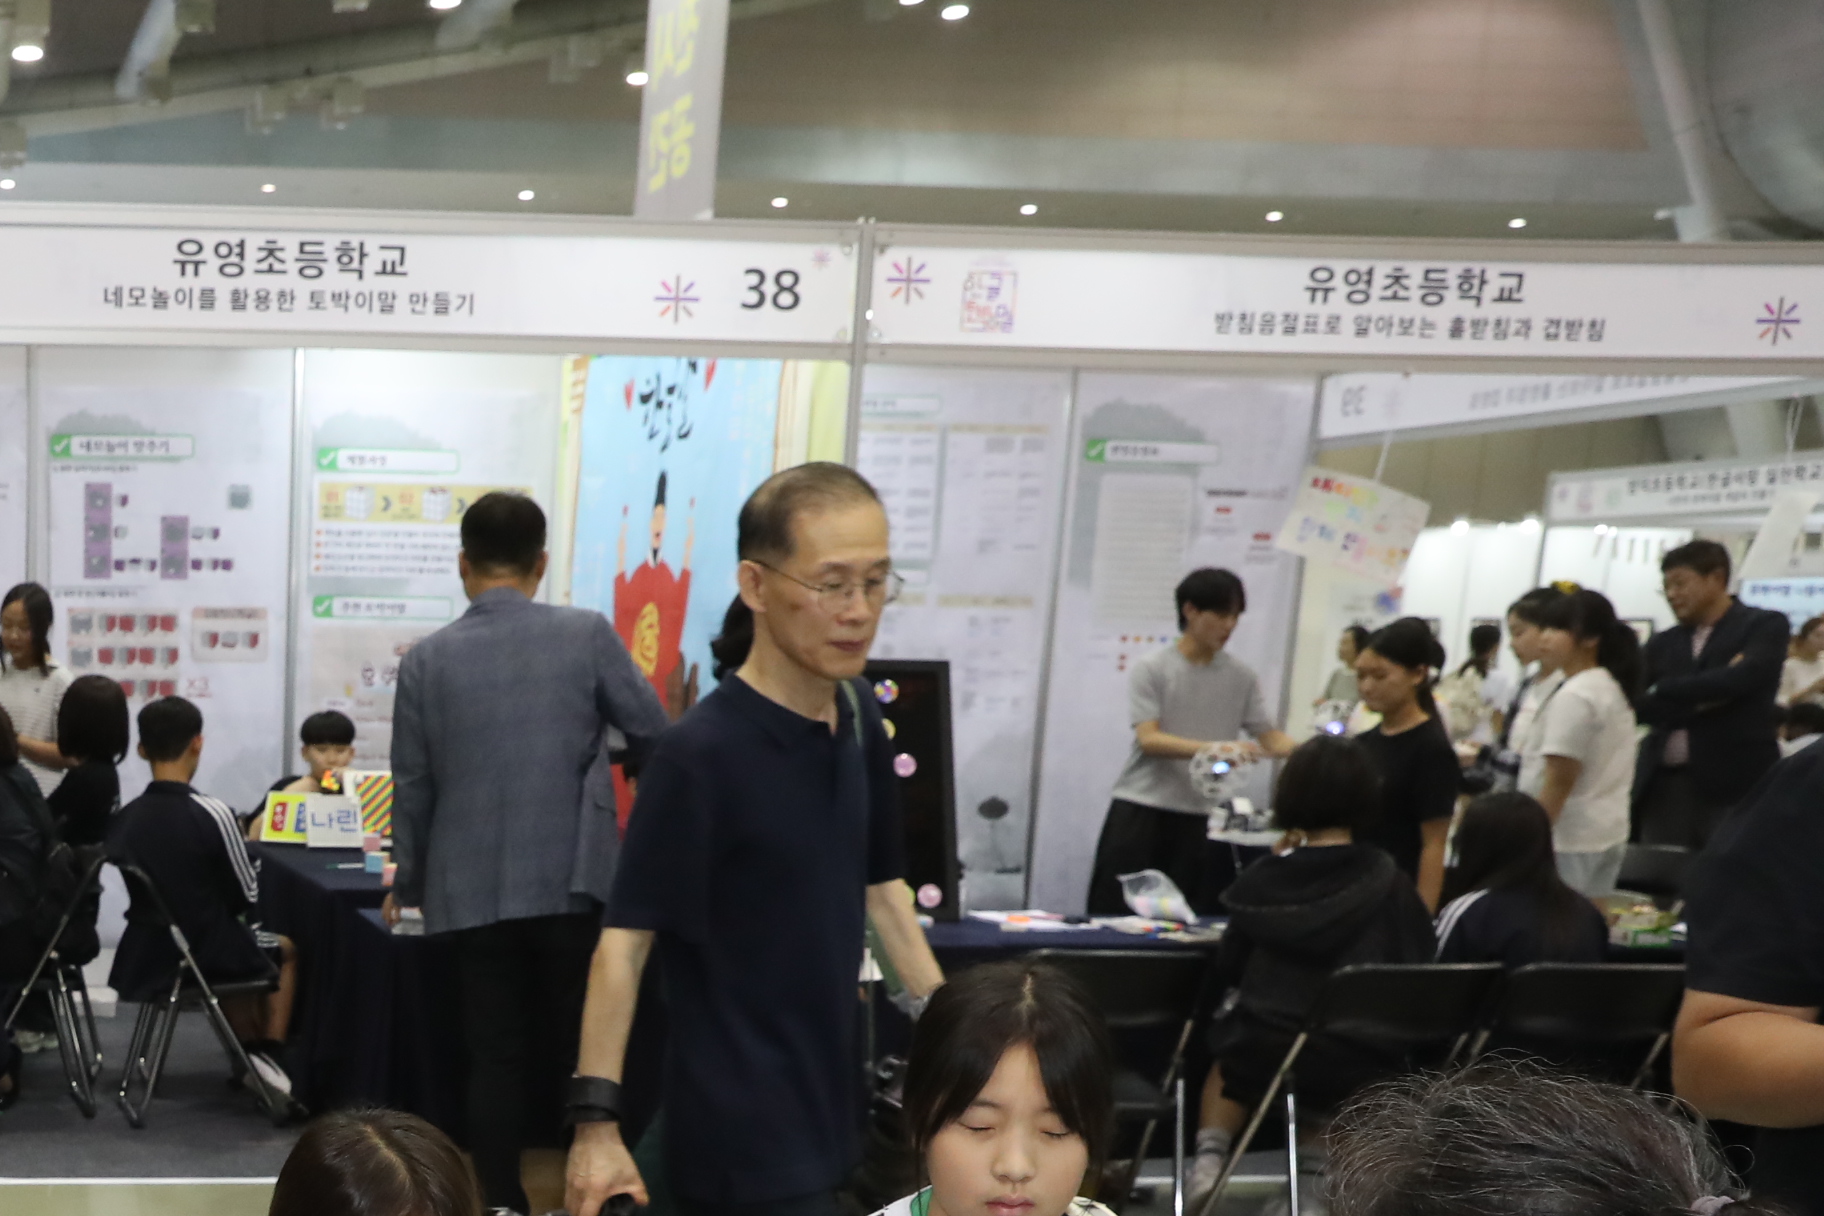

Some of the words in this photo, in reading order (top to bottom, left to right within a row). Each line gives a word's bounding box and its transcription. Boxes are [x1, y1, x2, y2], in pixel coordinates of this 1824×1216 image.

[173, 238, 409, 280] 유영초등학교
[103, 285, 217, 312] 네모놀이를
[229, 288, 296, 313] 활용한
[307, 290, 399, 316] 토박이말
[409, 291, 476, 317] 만들기
[740, 267, 801, 311] 38
[1304, 265, 1526, 307] 유영초등학교
[1352, 314, 1439, 339] 알아보는
